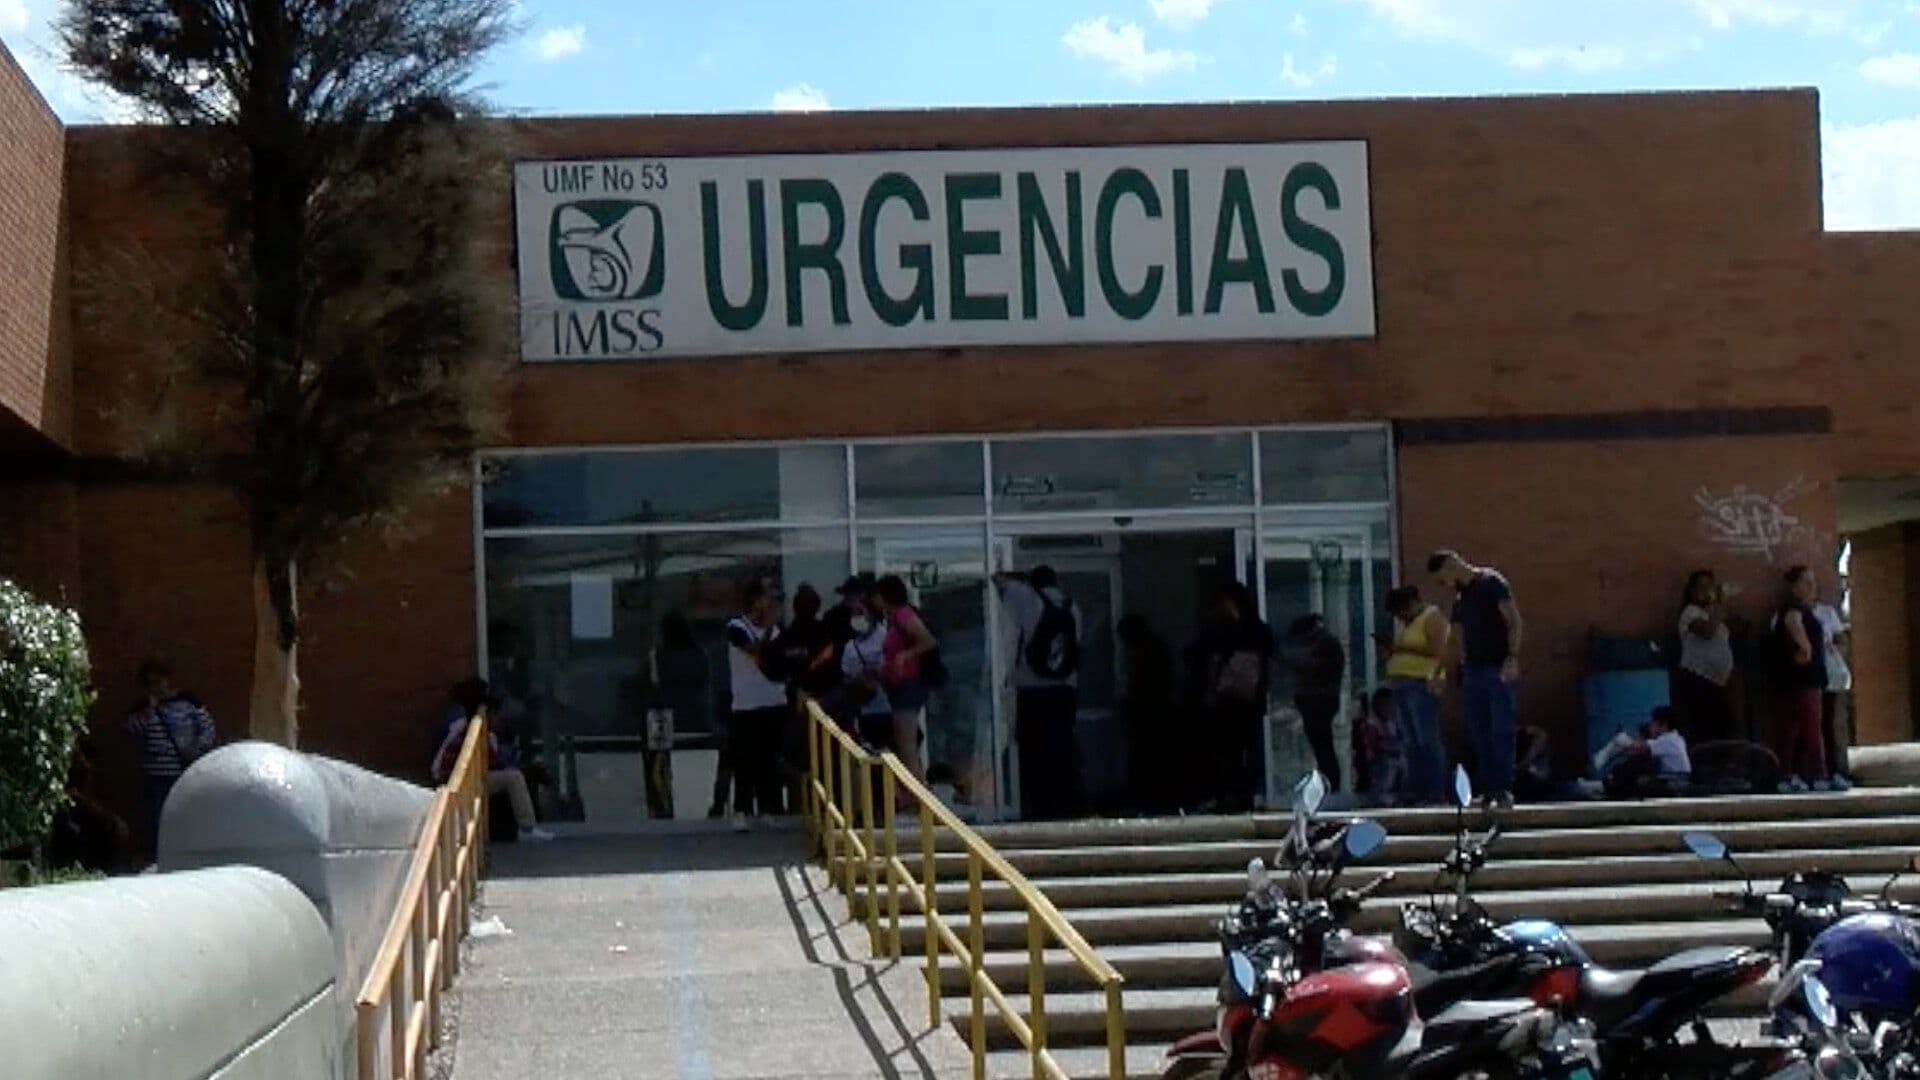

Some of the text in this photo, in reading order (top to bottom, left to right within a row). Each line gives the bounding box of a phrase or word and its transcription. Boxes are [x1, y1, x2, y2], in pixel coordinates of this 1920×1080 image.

[543, 162, 669, 193] UMF No 53
[700, 161, 1346, 332] URGENCIAS
[553, 309, 664, 356] IMSS
